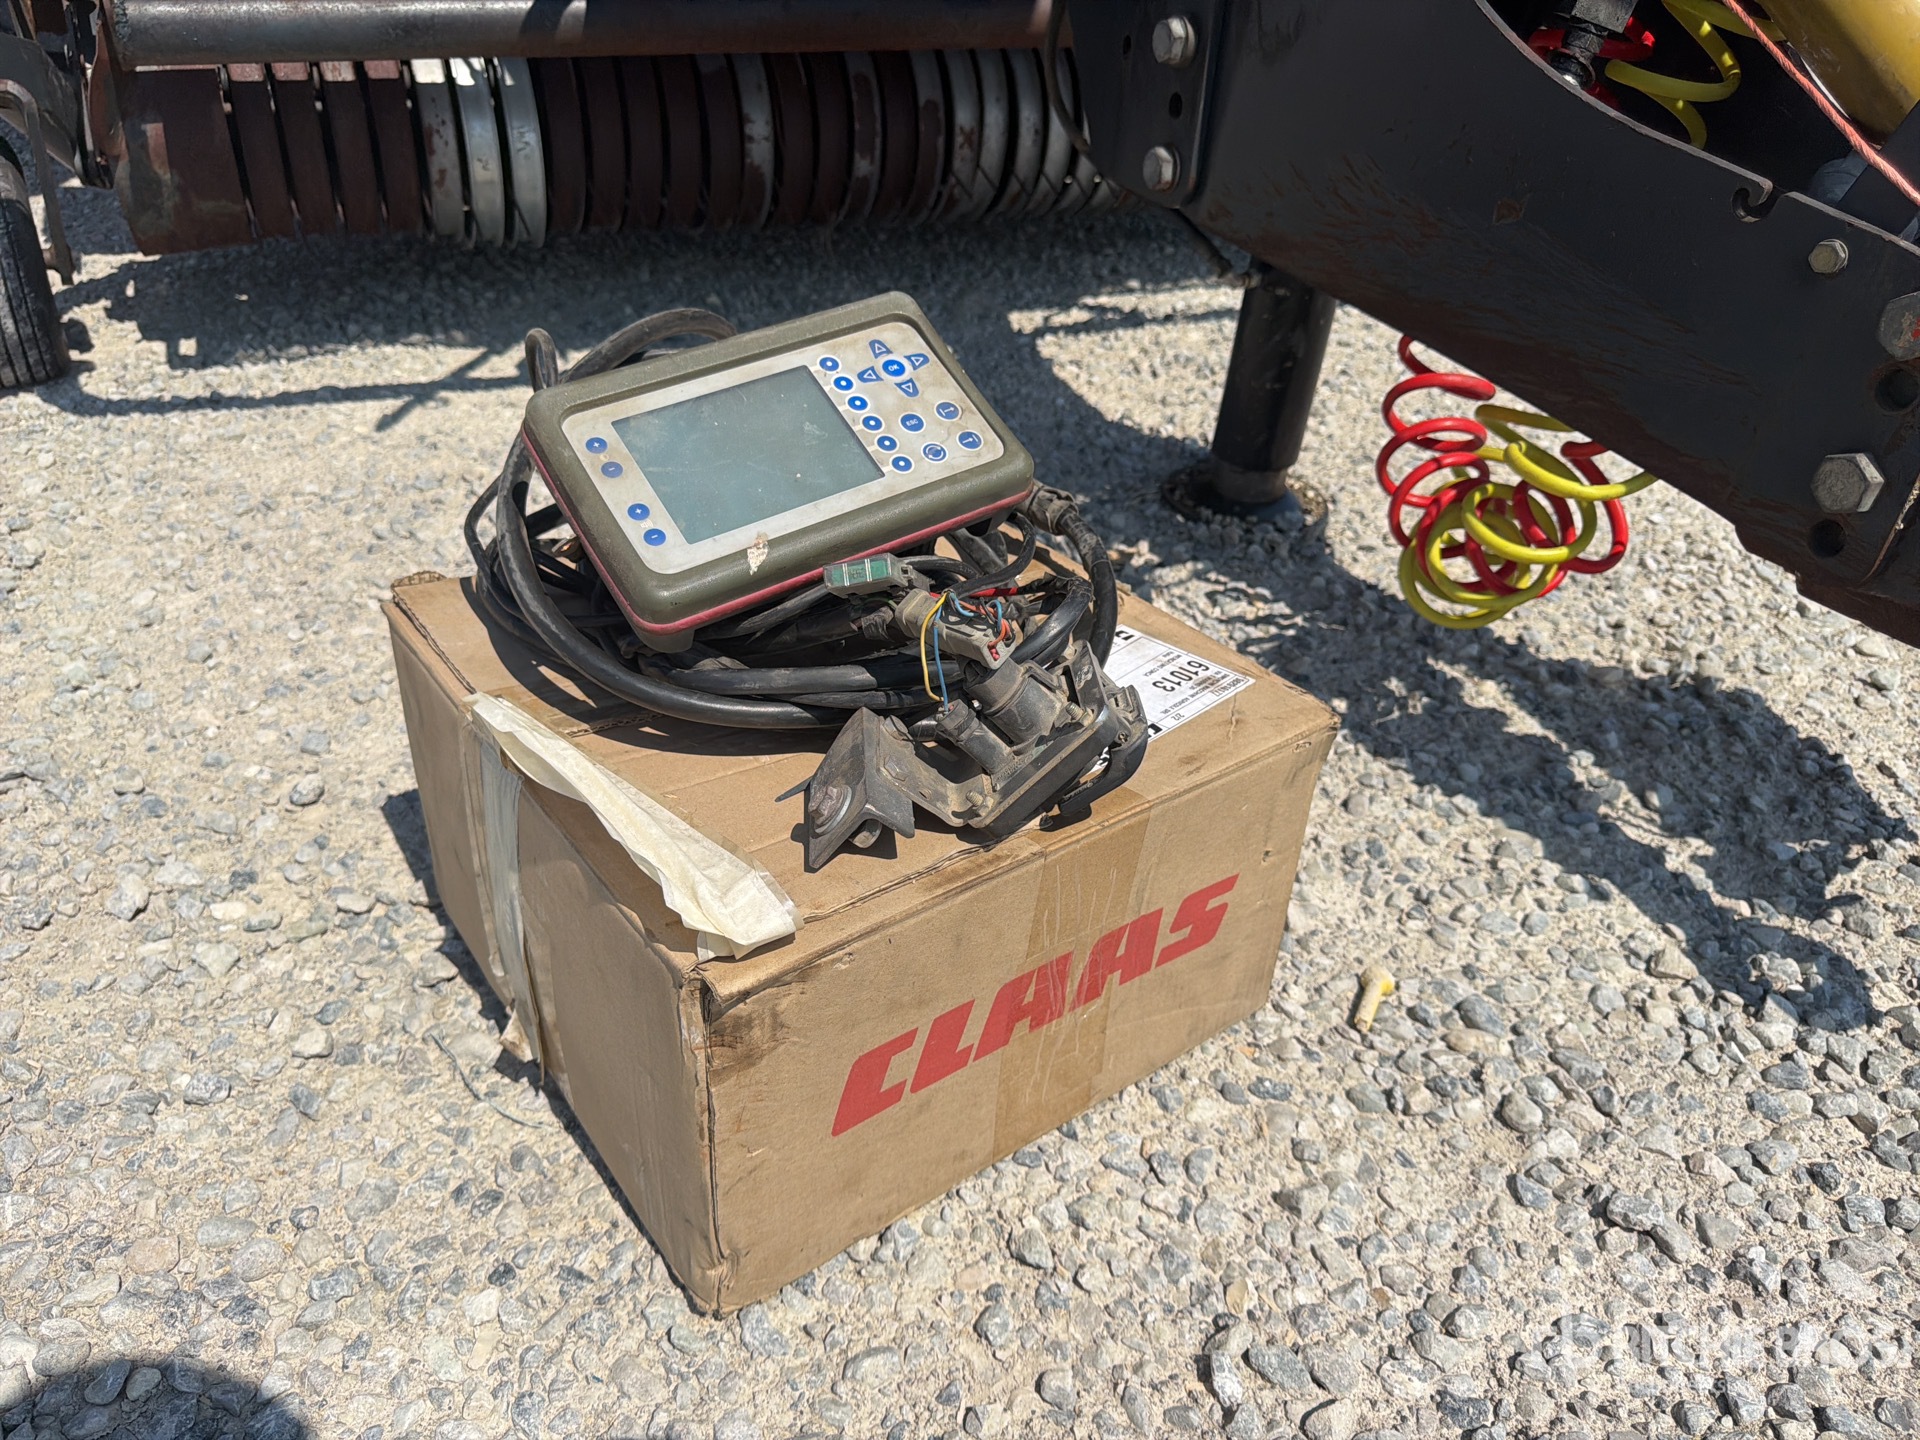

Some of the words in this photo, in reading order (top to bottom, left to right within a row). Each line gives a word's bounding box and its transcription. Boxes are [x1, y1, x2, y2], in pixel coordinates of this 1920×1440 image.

[888, 363, 900, 373] OK
[906, 418, 919, 427] ESC
[1152, 660, 1209, 693] 61013
[831, 873, 1240, 1137] CLAAS
